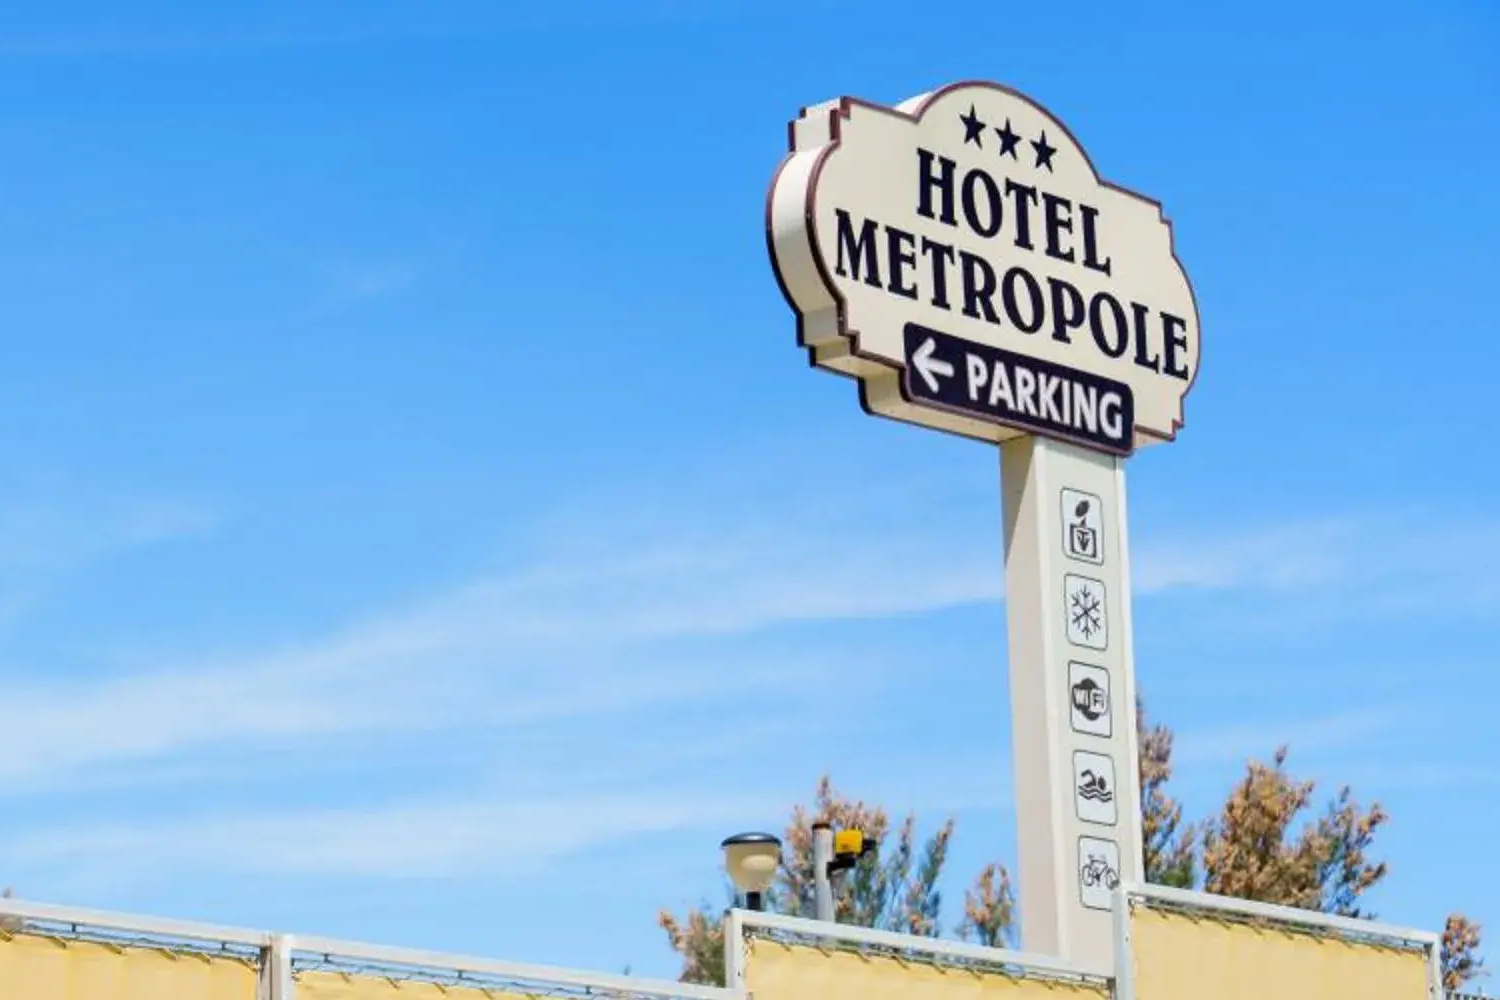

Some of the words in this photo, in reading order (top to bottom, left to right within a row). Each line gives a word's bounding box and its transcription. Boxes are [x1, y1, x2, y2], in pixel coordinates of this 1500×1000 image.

[917, 147, 1111, 277] HOTEL
[836, 208, 1188, 381] METROPOLE
[967, 354, 1122, 438] PARKING
